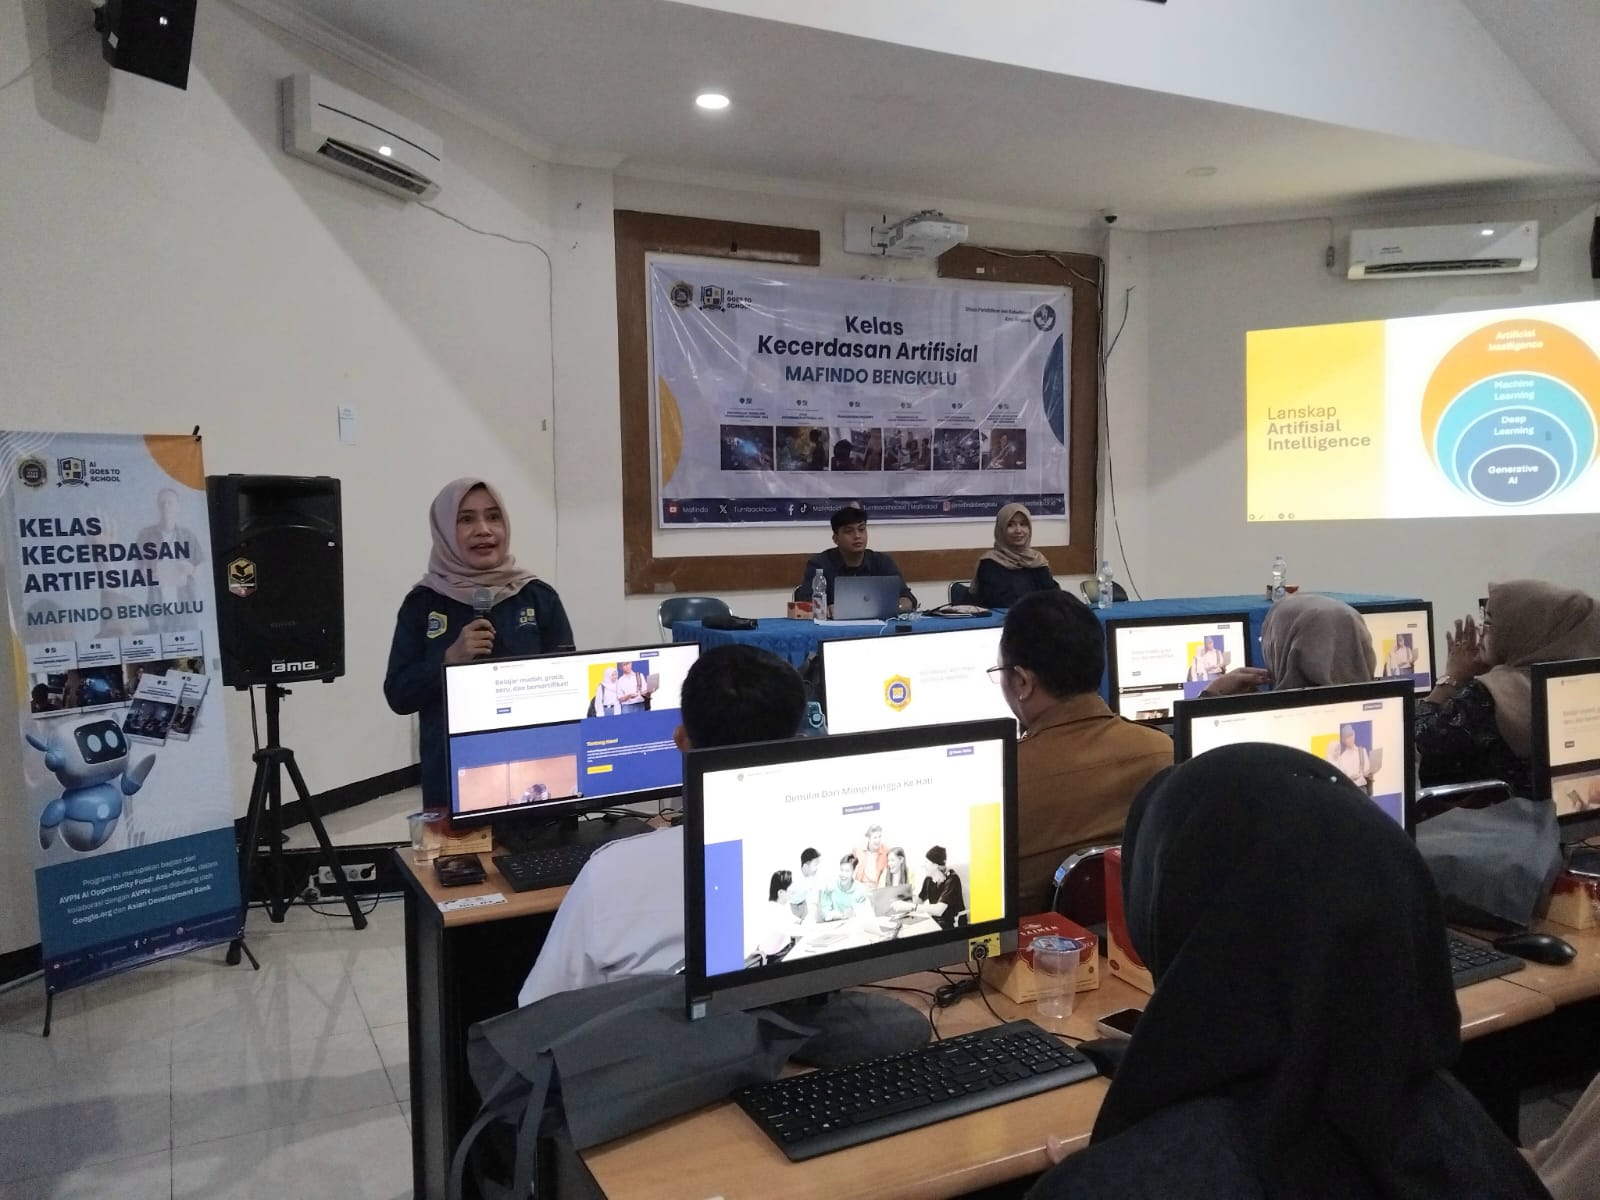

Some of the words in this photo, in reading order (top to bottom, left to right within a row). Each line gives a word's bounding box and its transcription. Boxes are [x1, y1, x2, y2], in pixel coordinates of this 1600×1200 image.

[845, 315, 904, 336] Kelas
[1495, 328, 1536, 341] Artificial
[757, 335, 891, 360] Kecerdasan
[896, 340, 979, 363] Artifisial
[1488, 340, 1544, 353] Intelligence
[785, 365, 868, 385] MAFINDO
[872, 369, 957, 387] BENGKULU
[1493, 378, 1535, 390] Machine
[1493, 390, 1535, 402] Learning
[1267, 405, 1337, 421] Lanskap
[1500, 414, 1527, 426] Deep
[1267, 420, 1342, 436] Artifisial
[1493, 425, 1535, 437] Learning
[1267, 434, 1371, 452] Intelligence
[89, 460, 97, 468] AI
[1487, 464, 1539, 475] Generative
[90, 475, 121, 483] SCHOOL
[1508, 475, 1519, 485] AI
[19, 517, 102, 538] KELAS
[22, 541, 190, 566] KECERDASAN
[24, 569, 160, 593] ARTIFISIAL
[27, 606, 114, 626] MAFINDO
[117, 600, 204, 620] BENGKULU
[59, 893, 81, 905] AVPN
[81, 891, 90, 899] AI
[90, 881, 134, 897] Opportunity
[130, 888, 151, 899] AVPN
[72, 909, 113, 925] Google.org
[127, 900, 148, 911] Asian
[148, 888, 194, 906] Development
[194, 883, 212, 894] Bank
